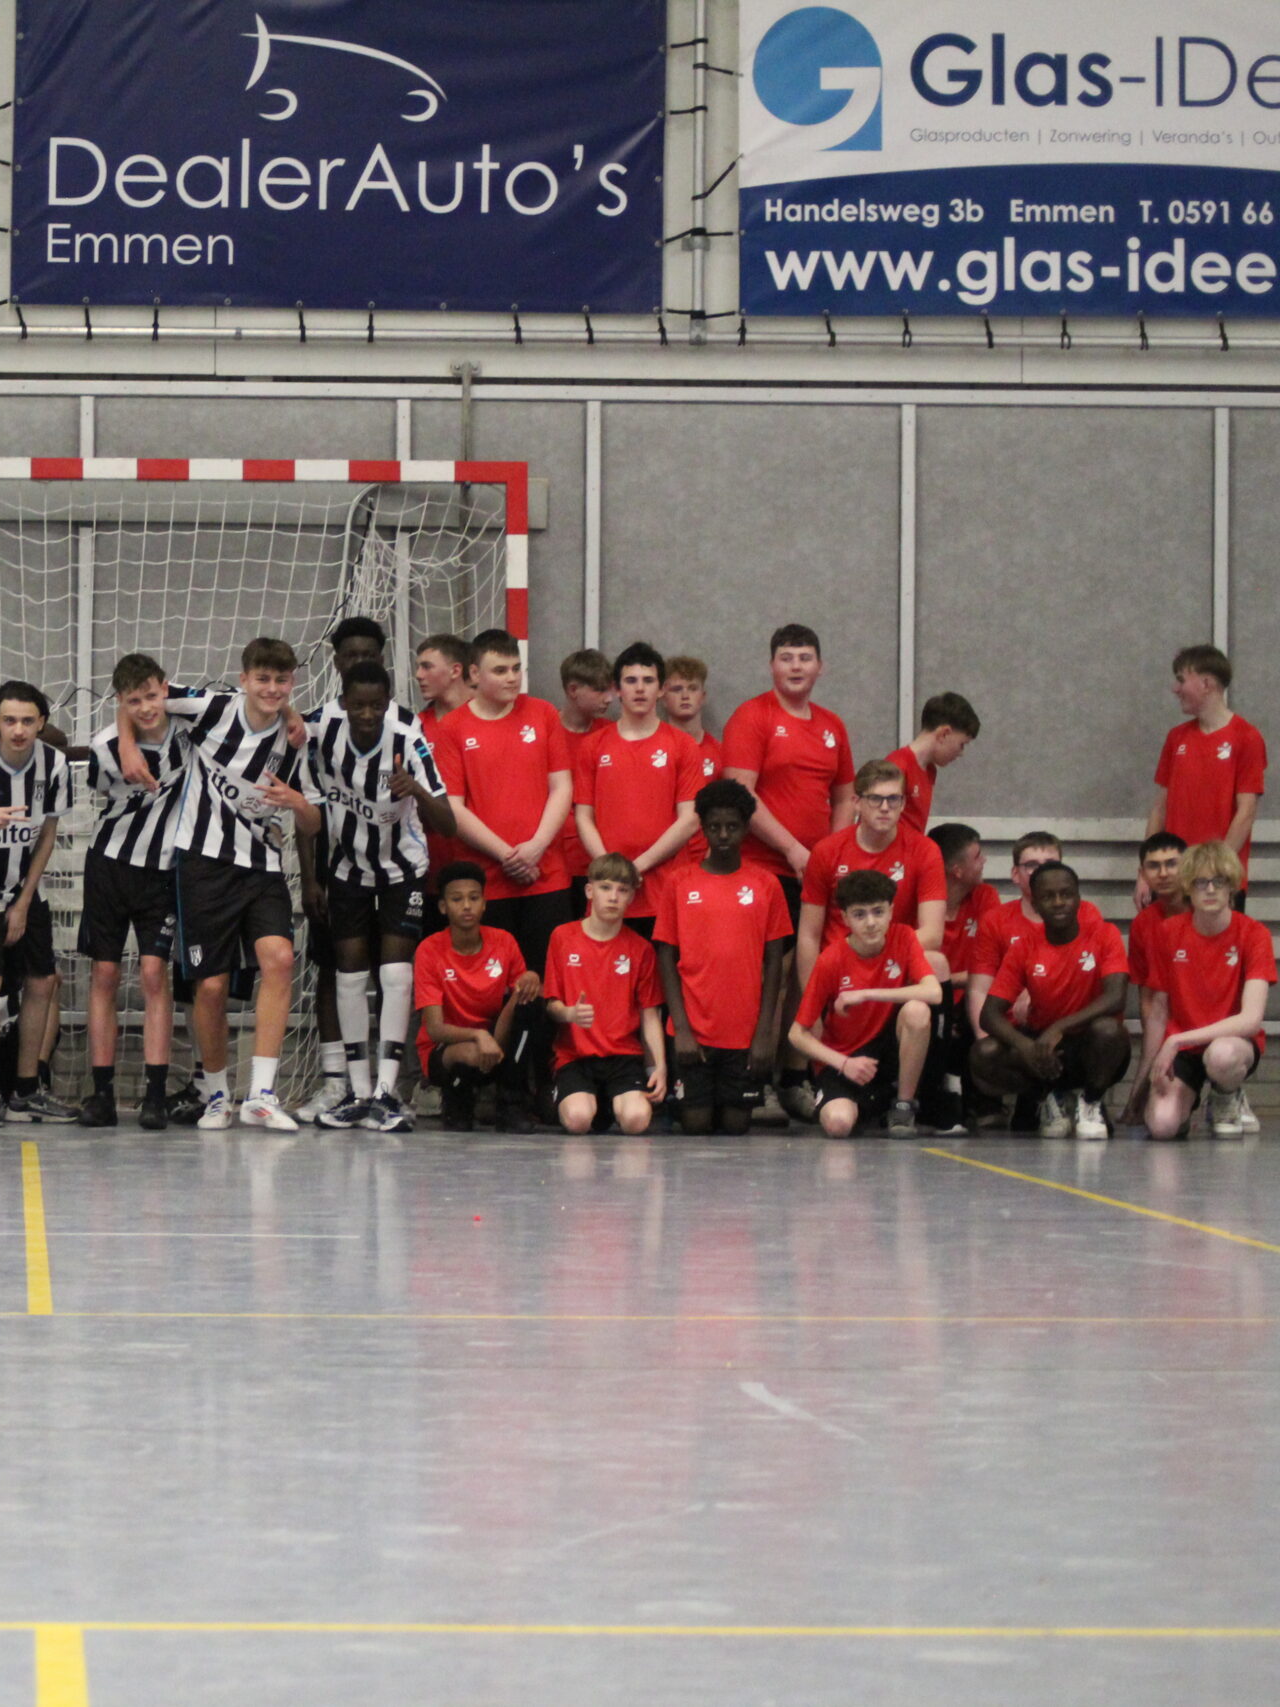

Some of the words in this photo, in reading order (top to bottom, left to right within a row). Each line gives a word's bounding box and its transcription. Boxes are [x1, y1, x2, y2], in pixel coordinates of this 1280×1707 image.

[909, 127, 1030, 145] Glasproducten
[1049, 128, 1132, 147] Zonwering
[1151, 129, 1233, 145] Veranda's
[47, 137, 628, 217] DealerAuto's
[765, 198, 940, 228] Handelsweg
[949, 198, 984, 222] 3b
[1010, 199, 1115, 224] Emmen
[1140, 200, 1159, 224] T.
[1168, 200, 1229, 225] 0591
[1242, 201, 1274, 225] 66
[47, 223, 234, 265] Emmen
[765, 236, 1277, 306] www.glas-idee
[207, 768, 240, 800] ito
[326, 786, 373, 820] asito
